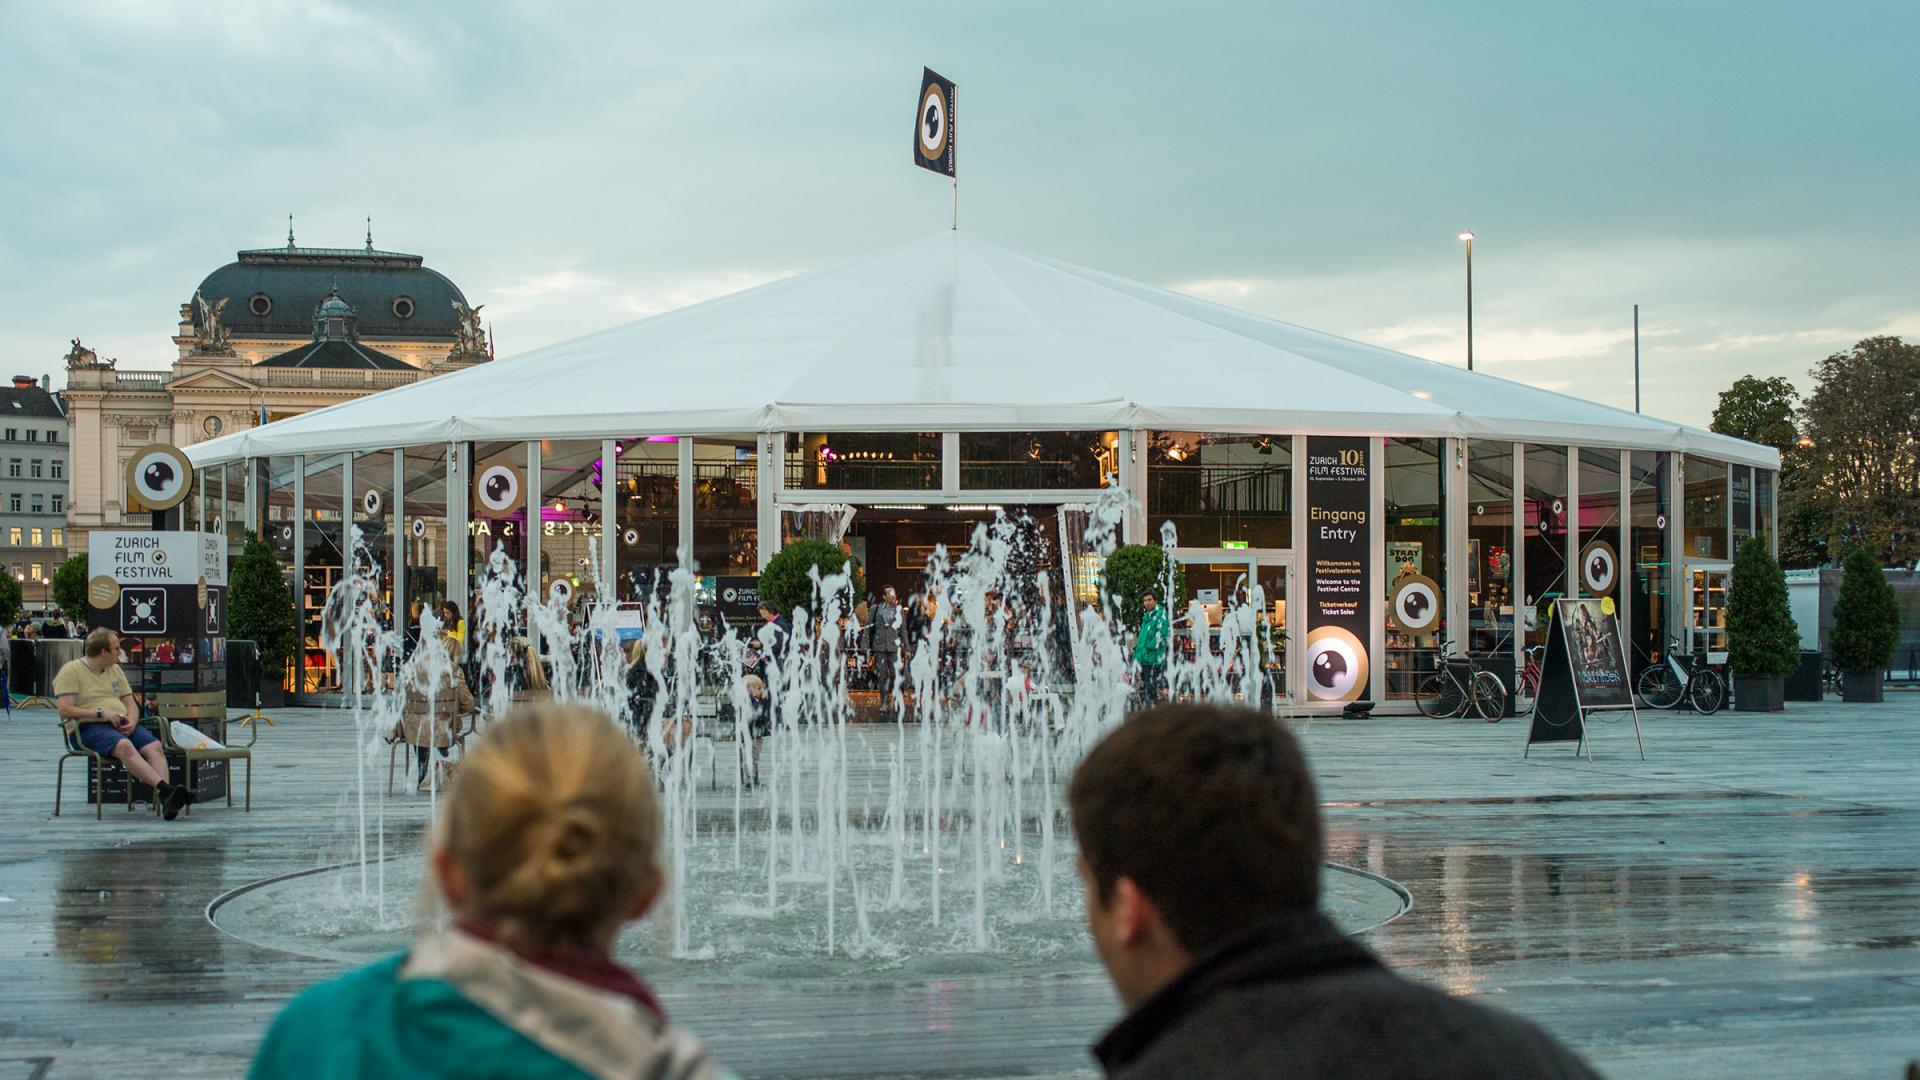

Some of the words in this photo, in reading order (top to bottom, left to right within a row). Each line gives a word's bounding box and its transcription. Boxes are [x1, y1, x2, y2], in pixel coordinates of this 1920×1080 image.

[1310, 456, 1338, 465] ZURICH
[1338, 450, 1359, 465] 10
[1310, 466, 1328, 475] FILM
[1330, 467, 1367, 475] FESTIVAL
[1311, 507, 1365, 524] Eingang
[1320, 527, 1357, 543] Entry
[115, 537, 159, 548] ZURICH
[114, 552, 145, 563] FILM
[114, 567, 173, 578] FESTIVAL
